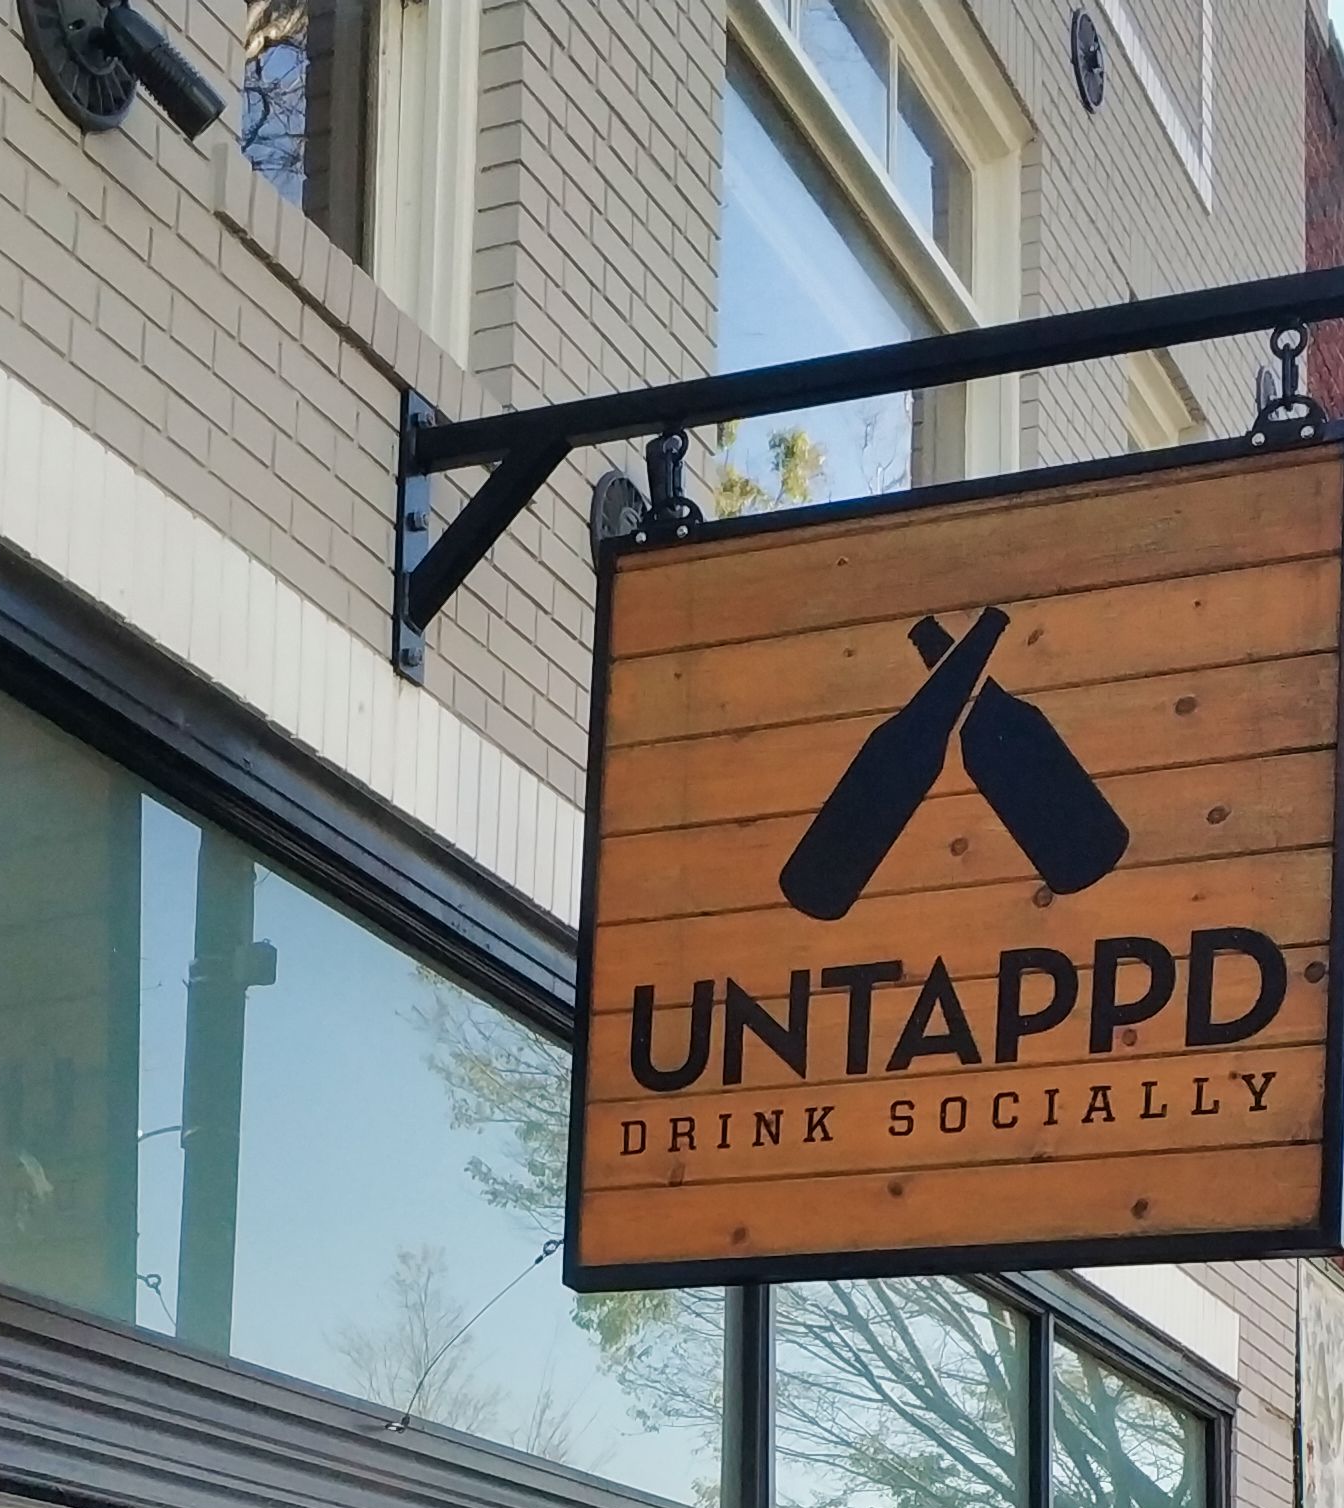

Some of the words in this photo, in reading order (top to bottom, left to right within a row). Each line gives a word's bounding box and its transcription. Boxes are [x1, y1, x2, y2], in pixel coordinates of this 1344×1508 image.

[630, 926, 1287, 1092] UNTAPPD
[620, 1105, 836, 1156] DRINK
[887, 1071, 1278, 1137] SOCIALLY
